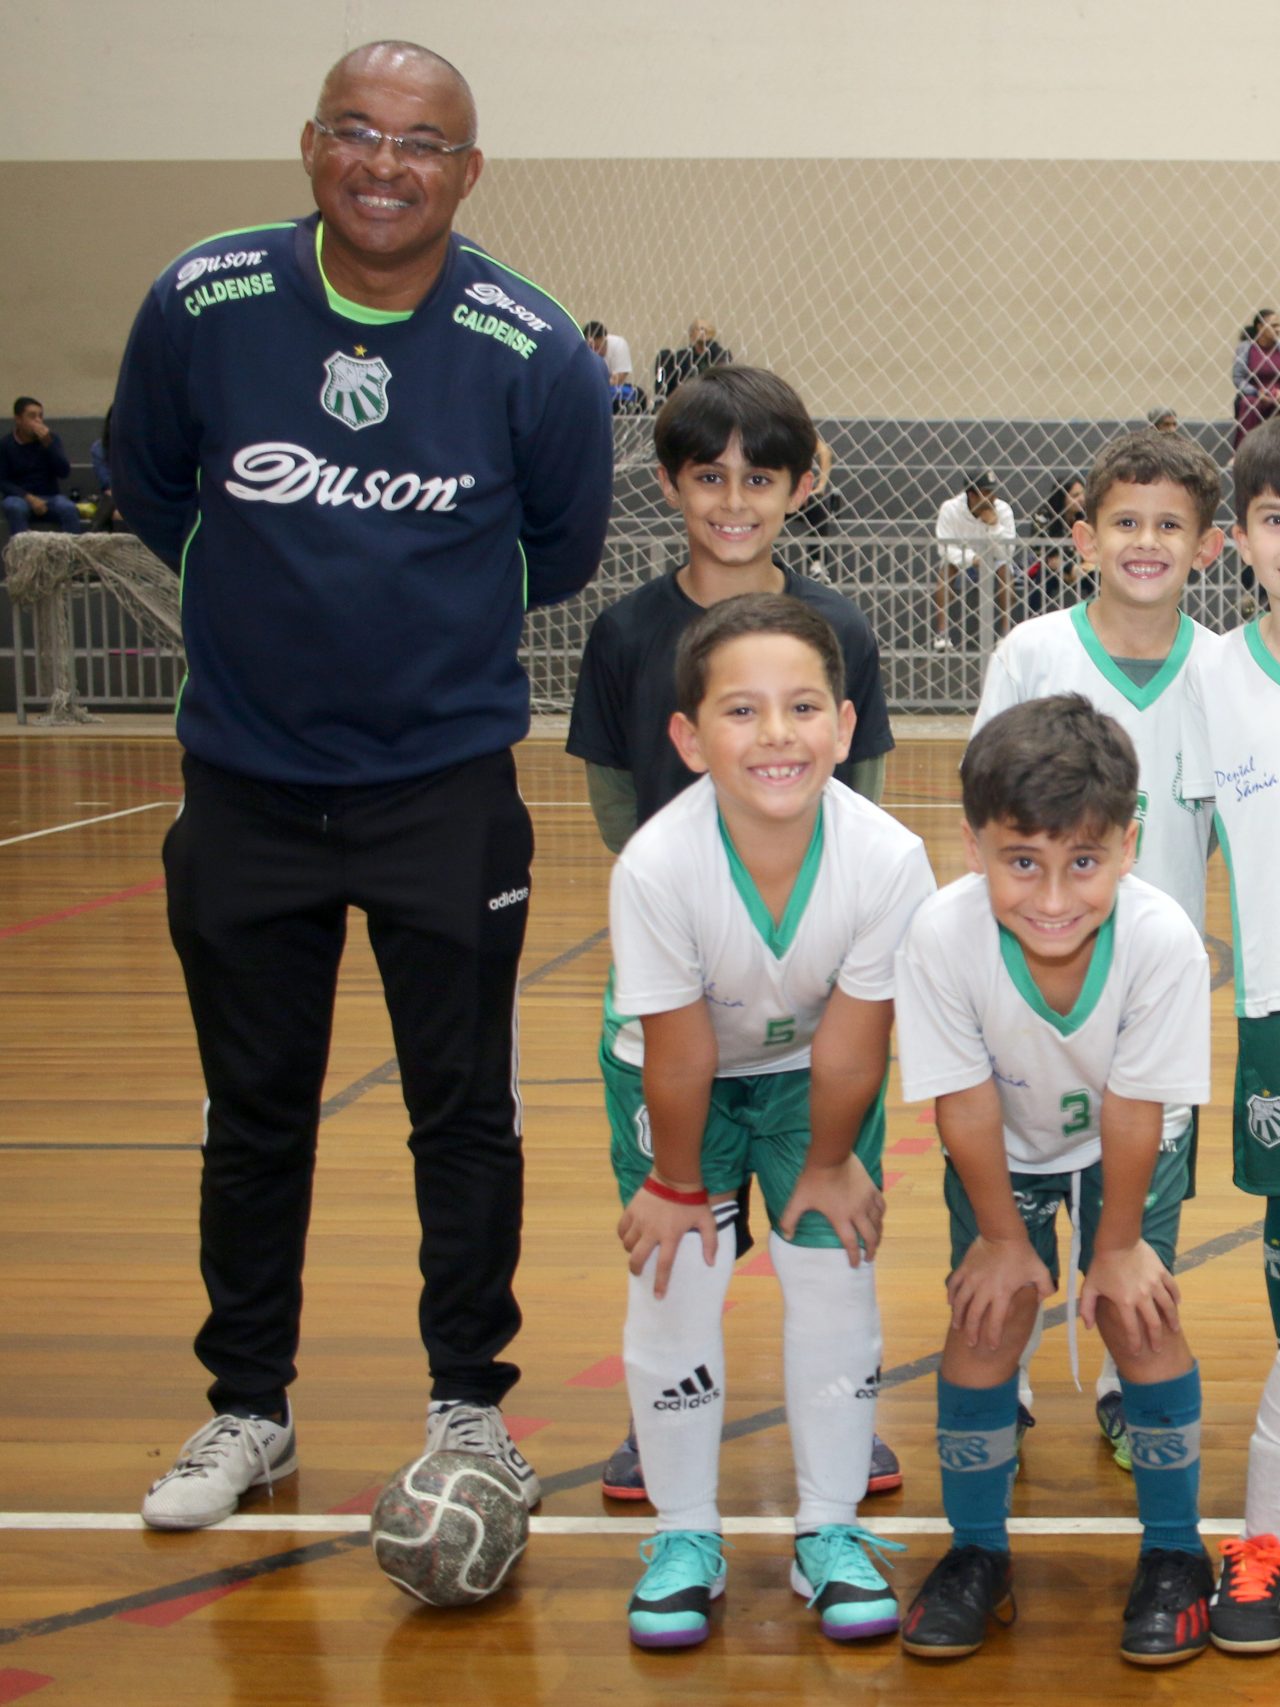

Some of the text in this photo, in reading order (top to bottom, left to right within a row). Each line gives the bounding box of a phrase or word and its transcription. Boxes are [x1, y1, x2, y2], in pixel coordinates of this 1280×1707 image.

[184, 272, 276, 317] CALDENSE
[453, 304, 538, 360] CALDENSE
[488, 886, 530, 911] adidas
[763, 1017, 796, 1047] 5
[1060, 1088, 1091, 1137] 3
[653, 1387, 721, 1412] adidas
